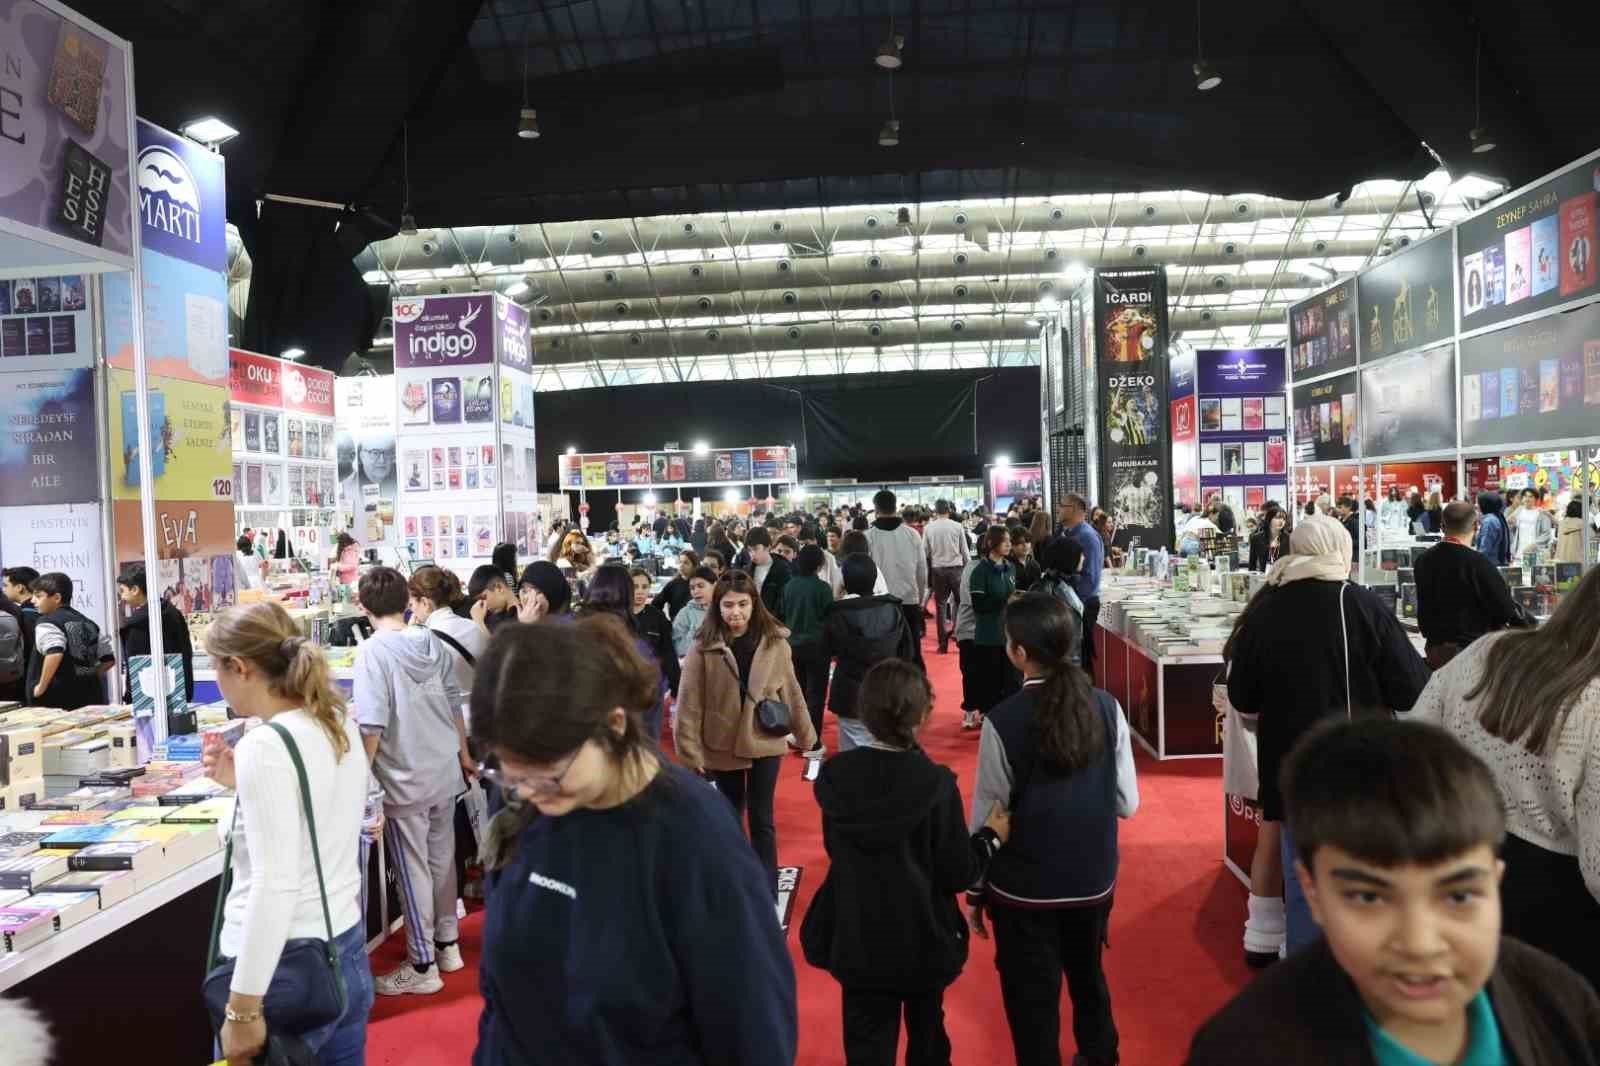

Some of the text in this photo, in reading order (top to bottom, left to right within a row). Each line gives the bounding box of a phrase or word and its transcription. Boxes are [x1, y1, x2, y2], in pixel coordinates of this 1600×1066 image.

[409, 332, 474, 358] indigo
[1109, 376, 1154, 388] DŽEKO
[10, 413, 77, 426] NEREDEYSE
[14, 430, 74, 444] SIRADAN
[32, 452, 57, 466] BİR
[31, 473, 61, 489] AİLE
[213, 479, 232, 497] 120
[160, 510, 198, 550] EVA
[32, 550, 92, 569] BEYNİNİ
